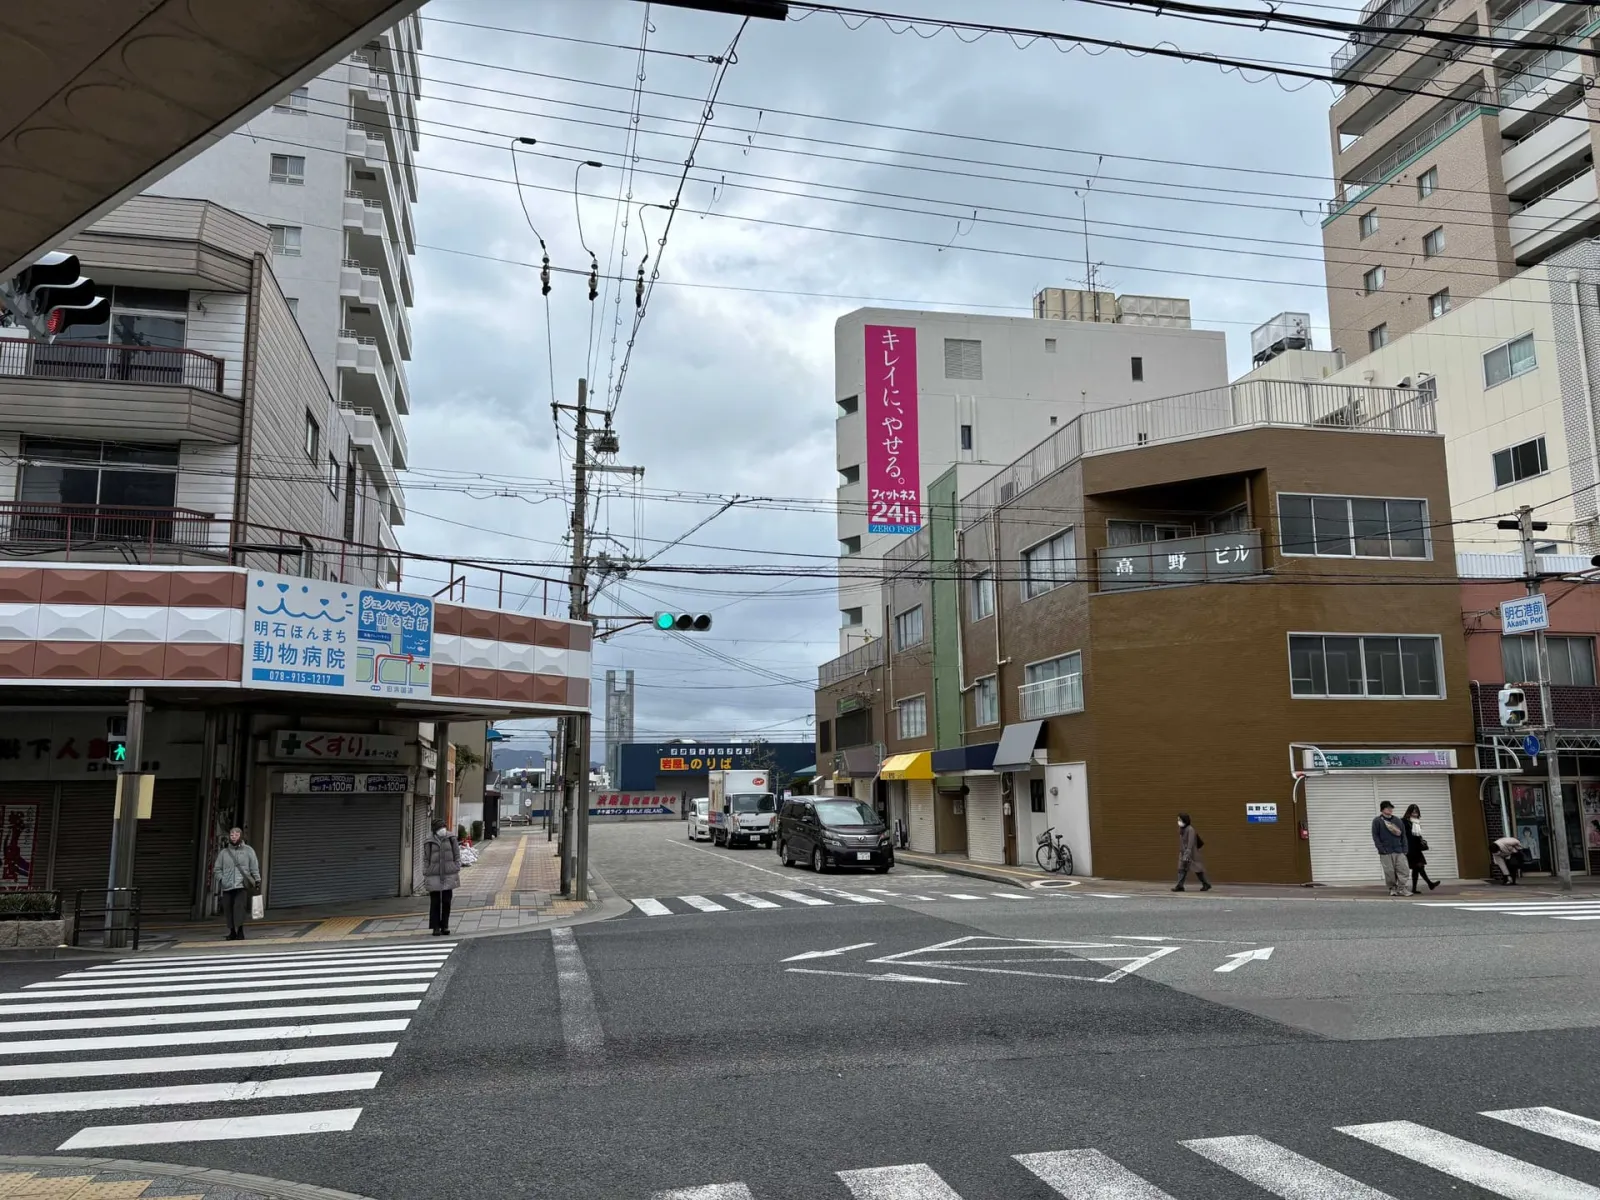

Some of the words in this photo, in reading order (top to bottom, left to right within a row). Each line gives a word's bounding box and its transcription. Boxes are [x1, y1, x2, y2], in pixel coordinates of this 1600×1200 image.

[882, 329, 905, 485] キレイに、やせる。
[871, 489, 916, 500] フィットネス
[872, 501, 917, 523] 24h
[872, 525, 895, 533] ZERO
[1116, 544, 1250, 576] 高野ビル
[362, 595, 429, 616] ジェノバライン
[1504, 601, 1543, 620] 明石港前
[361, 610, 429, 631] 手前を右折
[1507, 618, 1529, 628] Akashi
[1530, 616, 1544, 624] Port
[254, 620, 347, 644] 明石ほんまち
[252, 640, 346, 670] 動物病院
[269, 671, 331, 685] 078-915-1217
[304, 736, 363, 757] くすり
